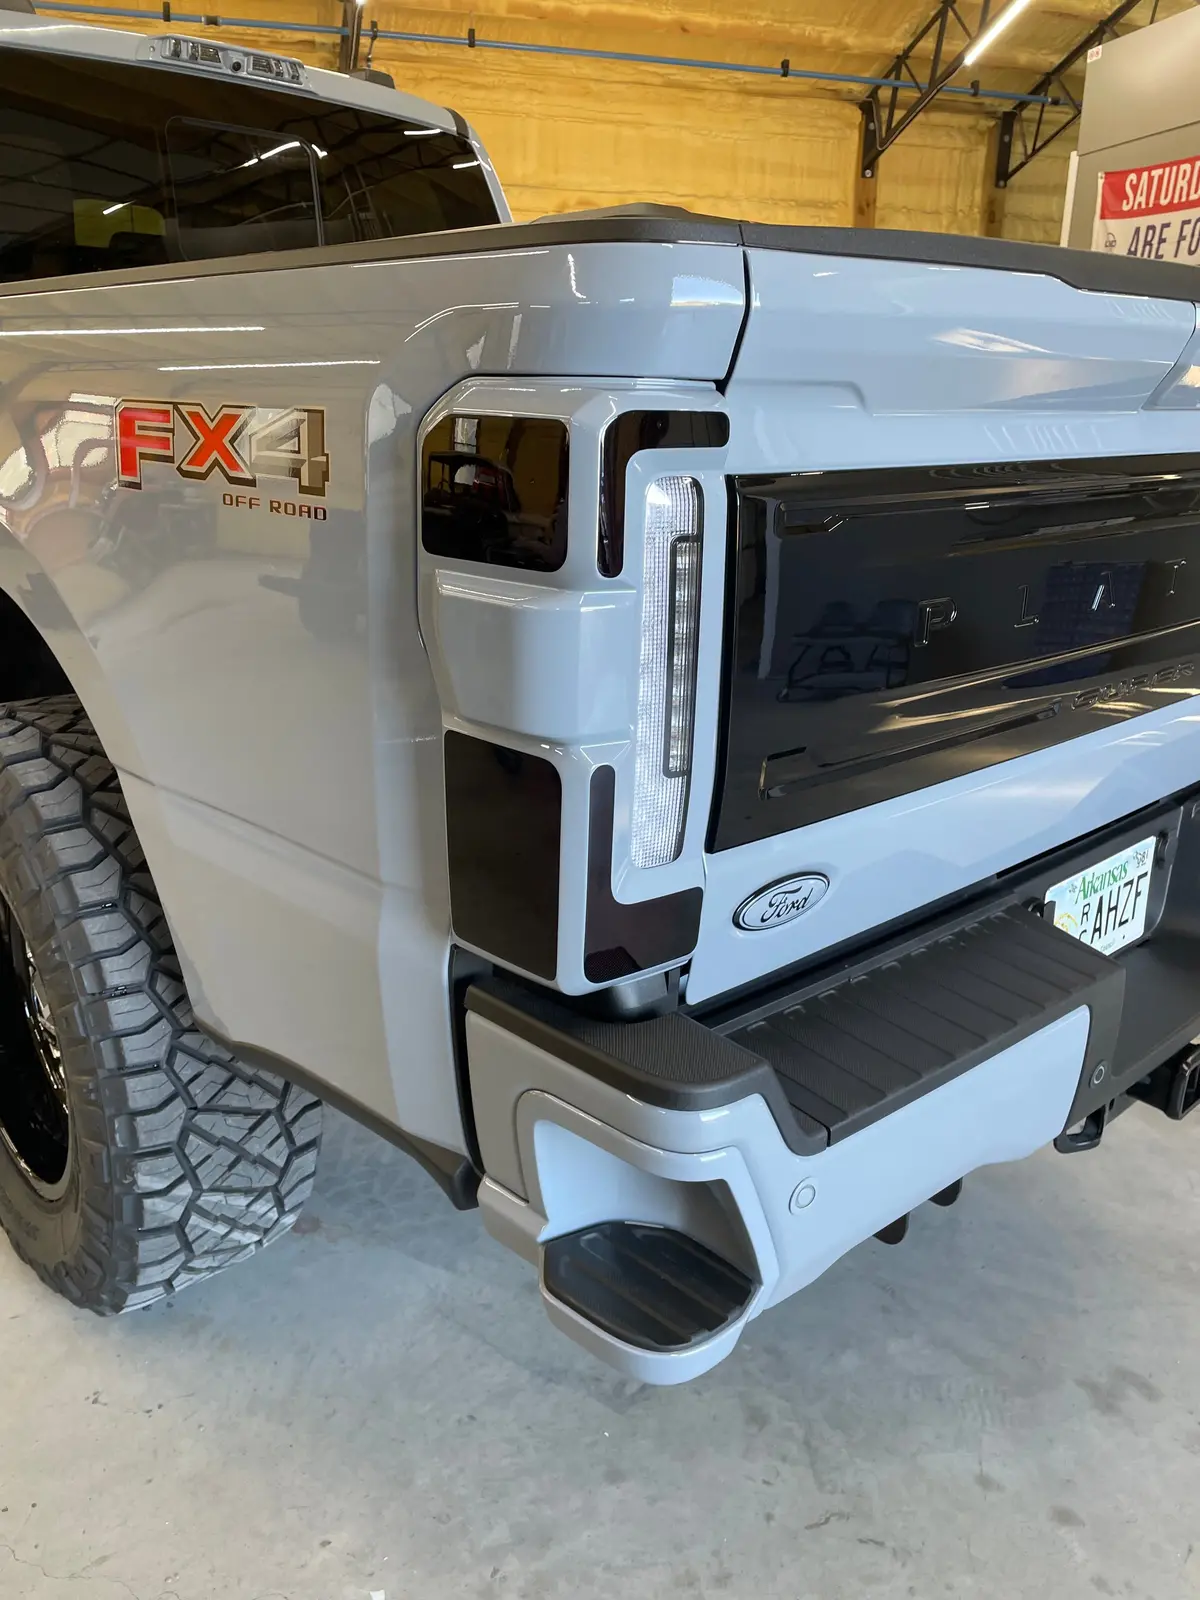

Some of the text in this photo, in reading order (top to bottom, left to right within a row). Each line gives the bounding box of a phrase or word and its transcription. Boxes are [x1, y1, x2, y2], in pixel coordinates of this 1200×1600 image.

[1126, 221, 1172, 260] ARE
[115, 398, 330, 497] FX4
[222, 493, 327, 521] OFF ROAD
[1075, 860, 1128, 905] Arkansas
[760, 885, 814, 923] Ford
[1090, 870, 1149, 944] AHZF
